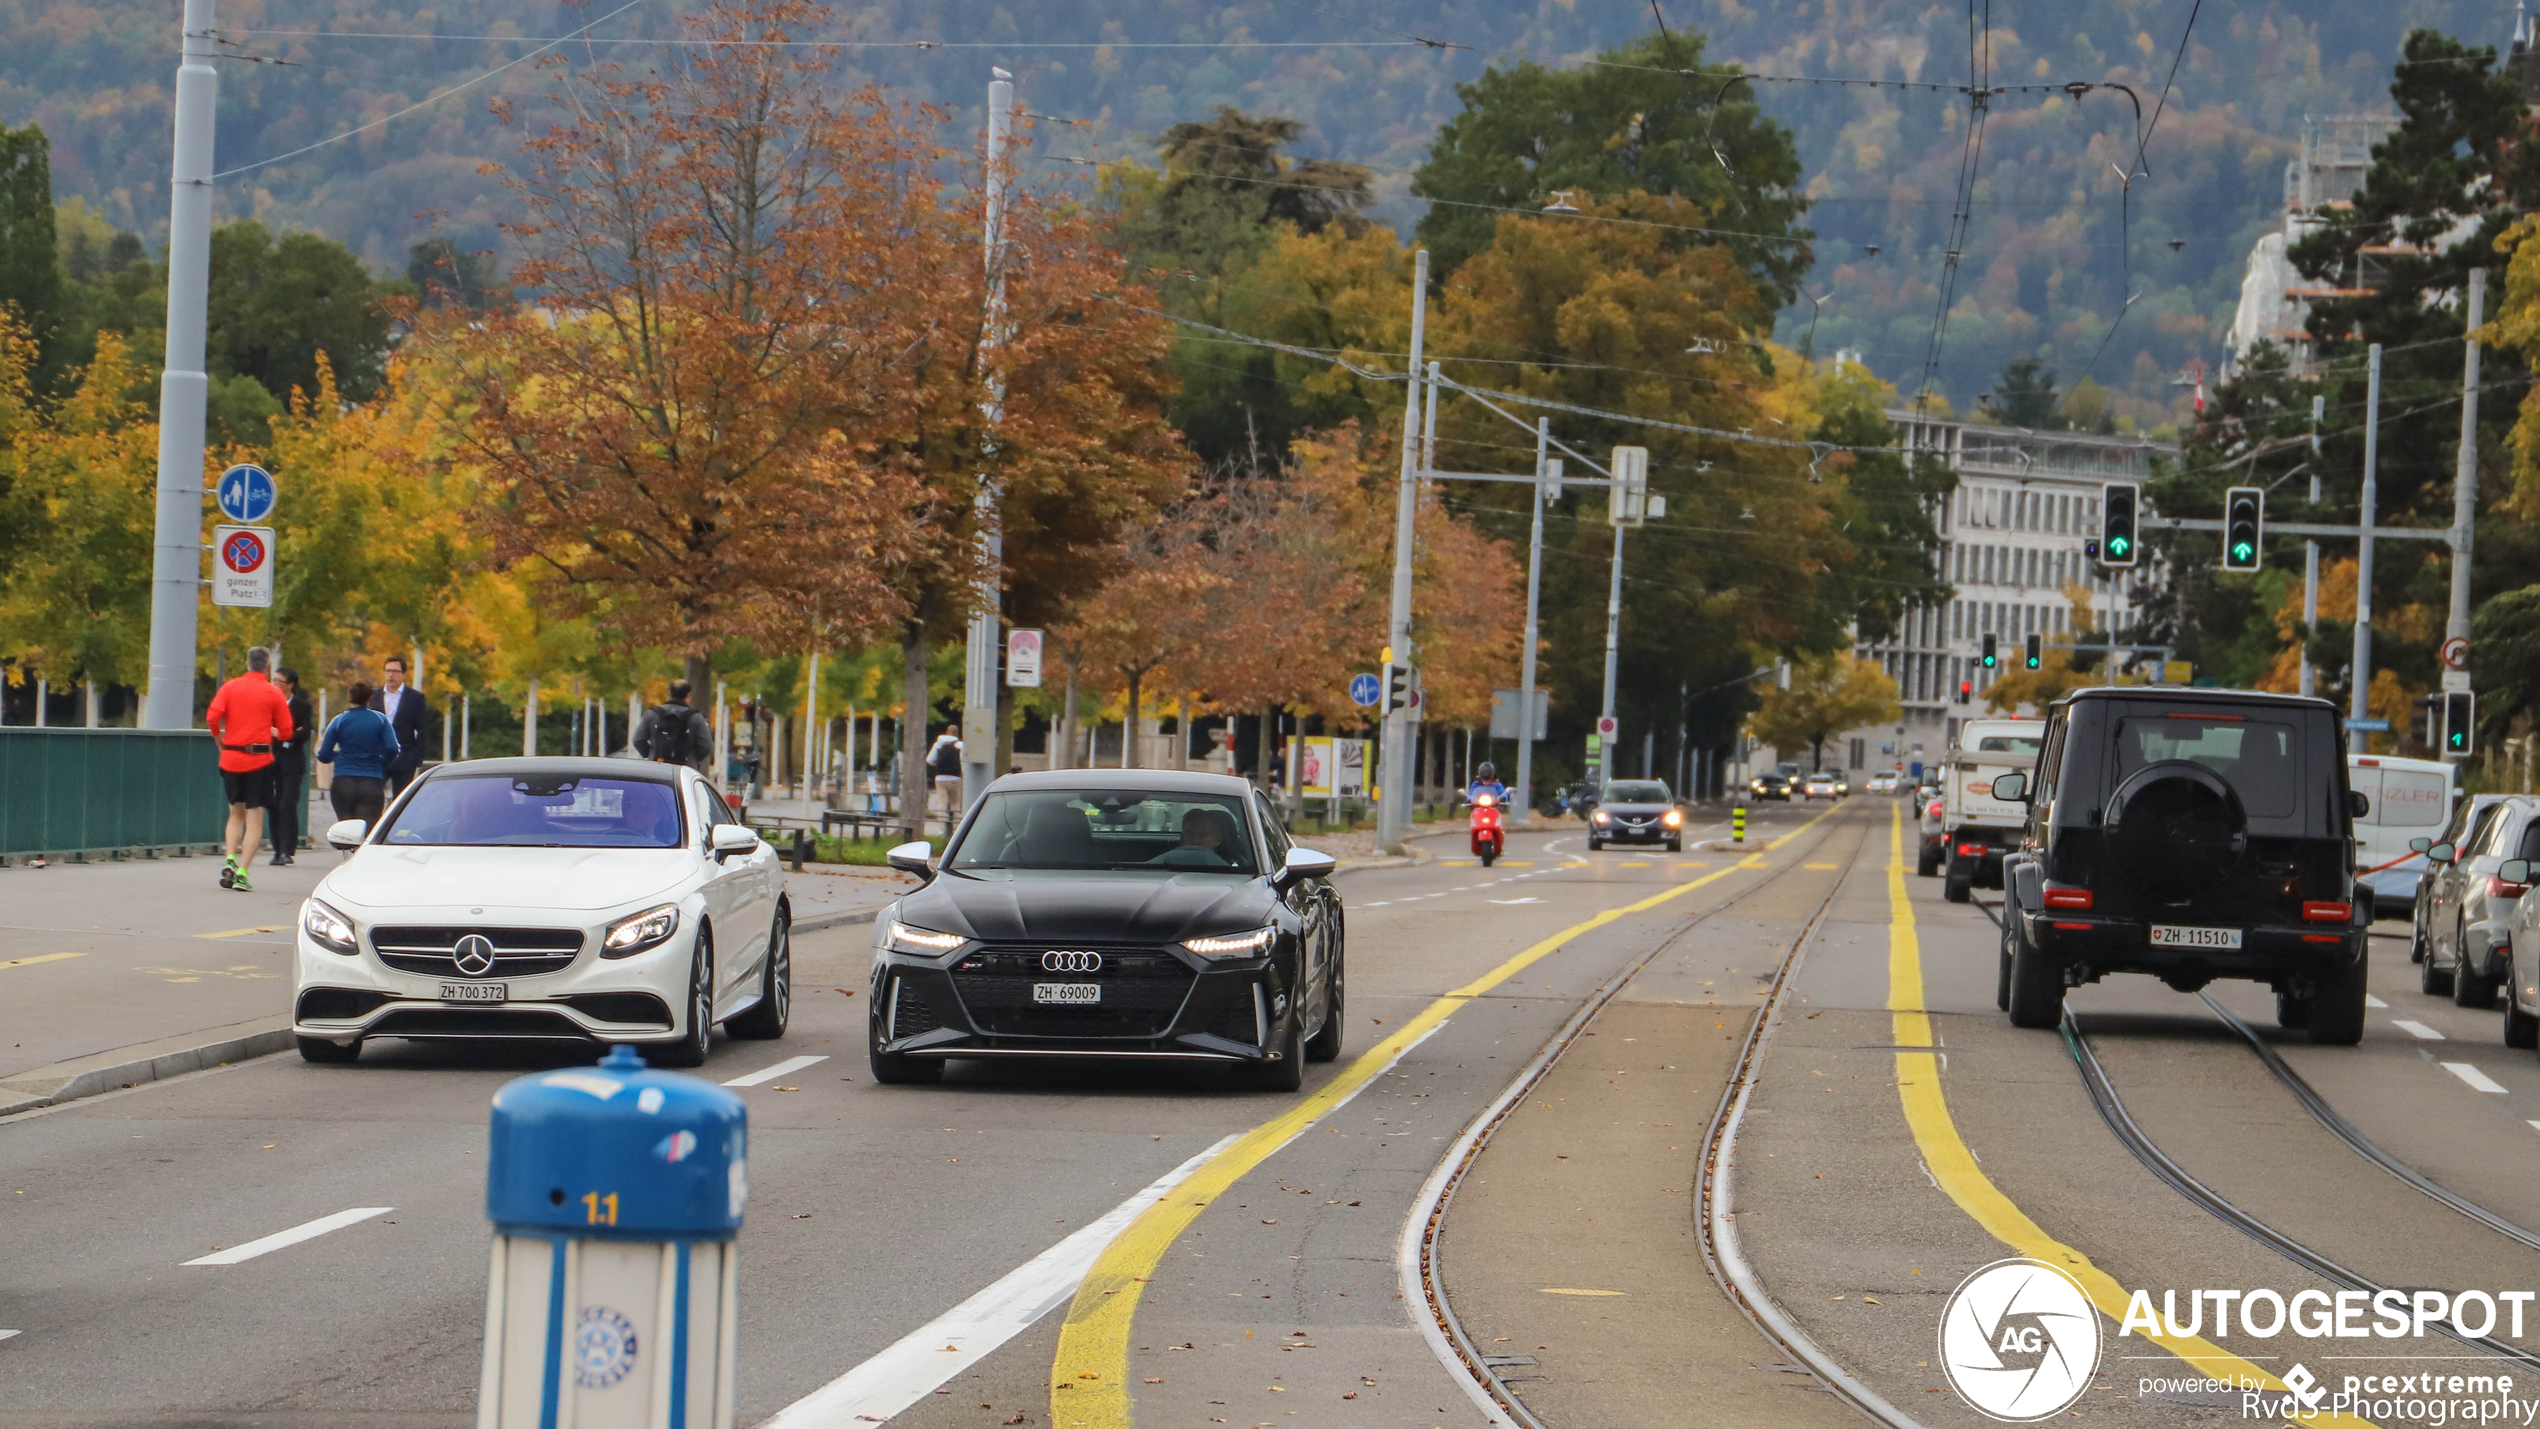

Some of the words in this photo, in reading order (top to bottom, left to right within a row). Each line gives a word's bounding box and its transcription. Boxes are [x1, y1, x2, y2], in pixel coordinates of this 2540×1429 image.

[227, 579, 258, 587] ganzer
[231, 589, 253, 598] Platz
[2363, 786, 2439, 803] ENZLER
